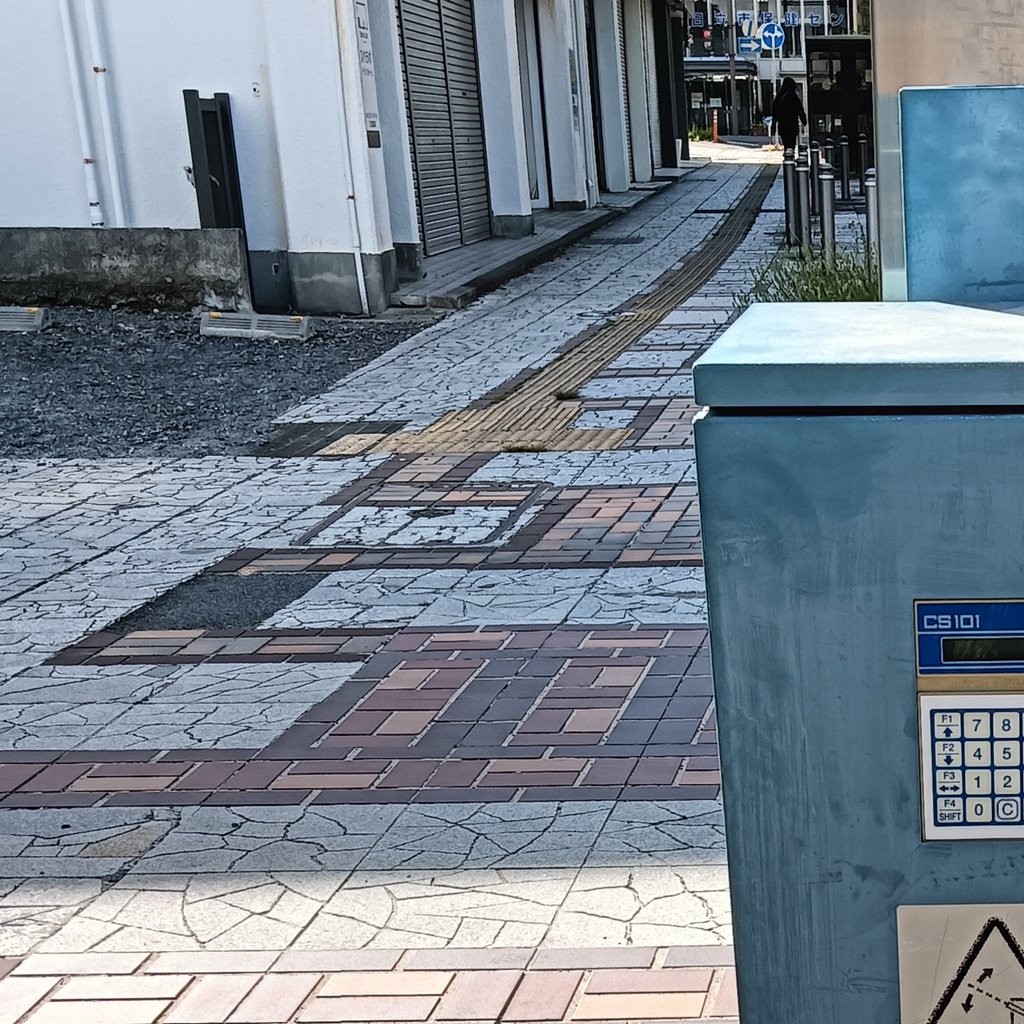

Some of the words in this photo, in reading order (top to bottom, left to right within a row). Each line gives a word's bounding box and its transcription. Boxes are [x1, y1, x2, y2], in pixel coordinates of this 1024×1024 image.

[923, 614, 981, 629] CS101
[941, 714, 953, 723] F1
[1001, 718, 1011, 732] 8
[972, 719, 982, 732] 7
[942, 743, 955, 752] F2
[972, 747, 982, 760] 4
[1002, 747, 1012, 760] 5
[943, 771, 956, 780] F3
[974, 775, 981, 788] 1
[1002, 775, 1012, 788] 2
[943, 799, 956, 808] F4
[974, 803, 984, 816] 0
[1002, 802, 1013, 816] C
[939, 812, 961, 821] SHIFT
